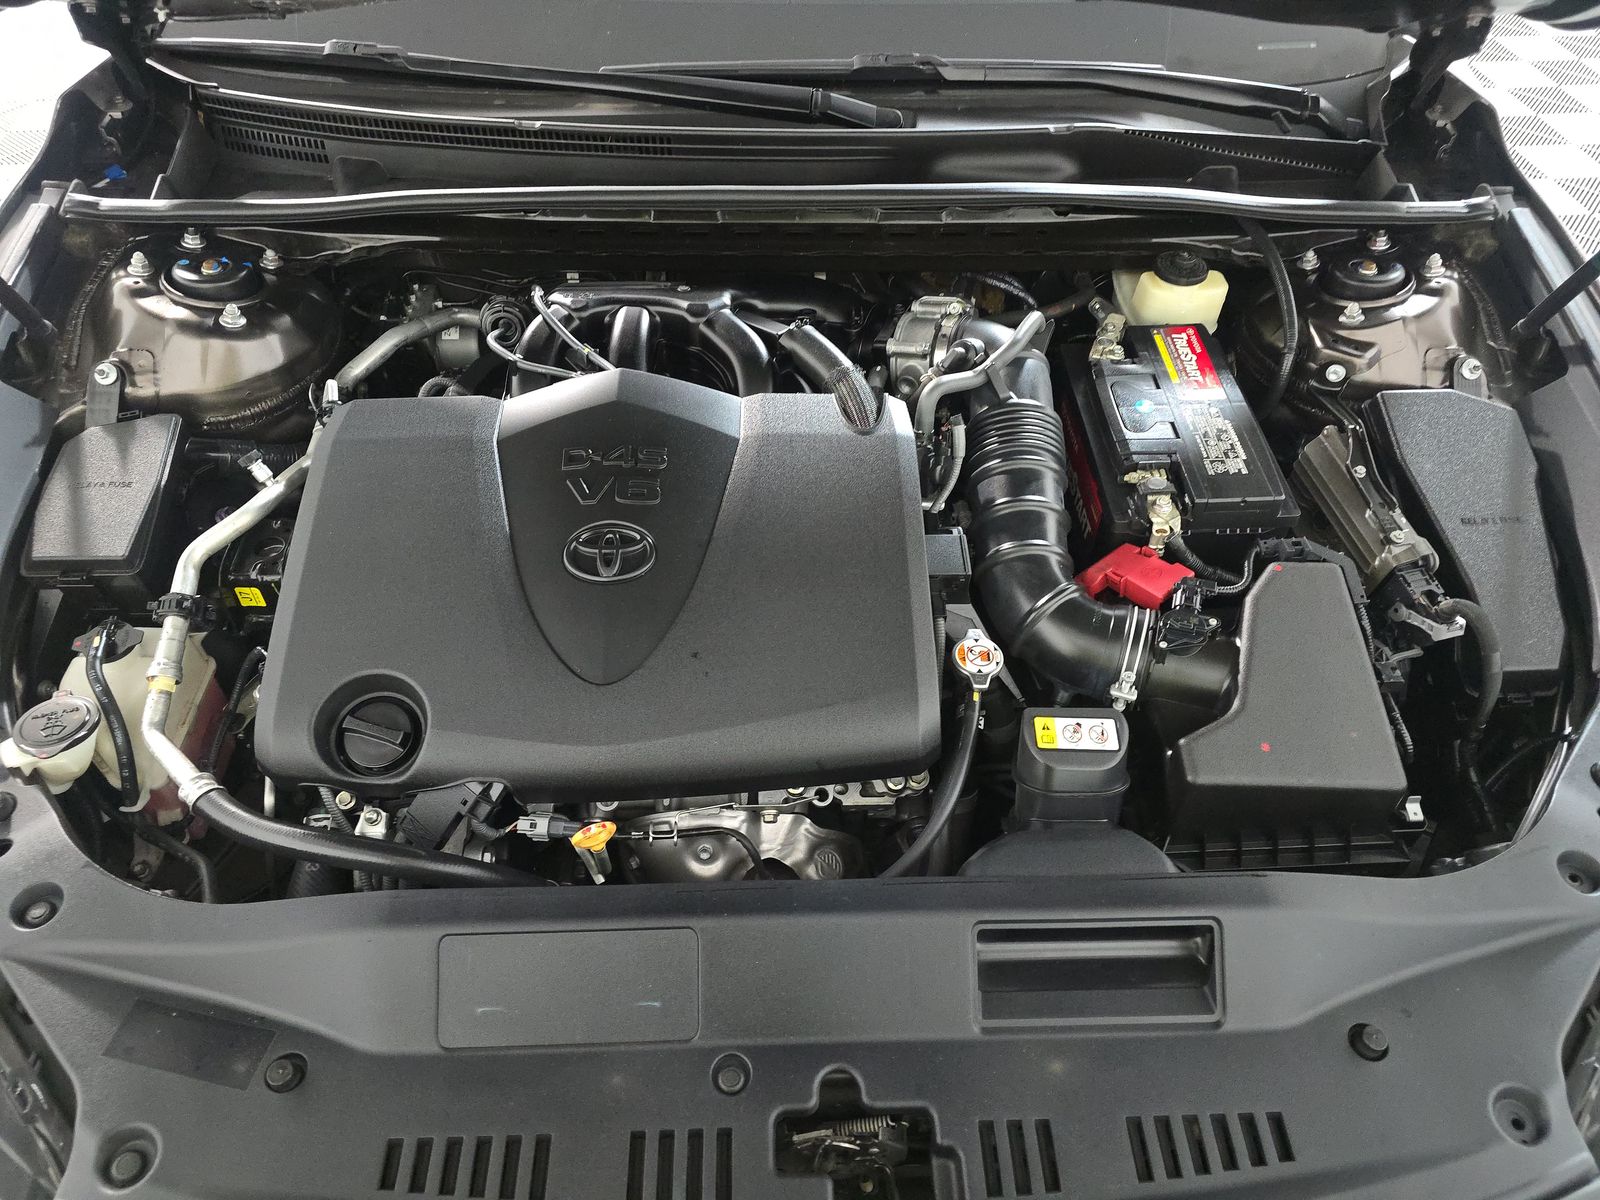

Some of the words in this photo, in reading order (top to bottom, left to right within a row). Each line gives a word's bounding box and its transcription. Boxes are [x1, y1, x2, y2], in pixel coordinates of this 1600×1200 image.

[561, 445, 668, 471] D-4S
[107, 481, 134, 489] FUSE
[566, 476, 662, 505] V6
